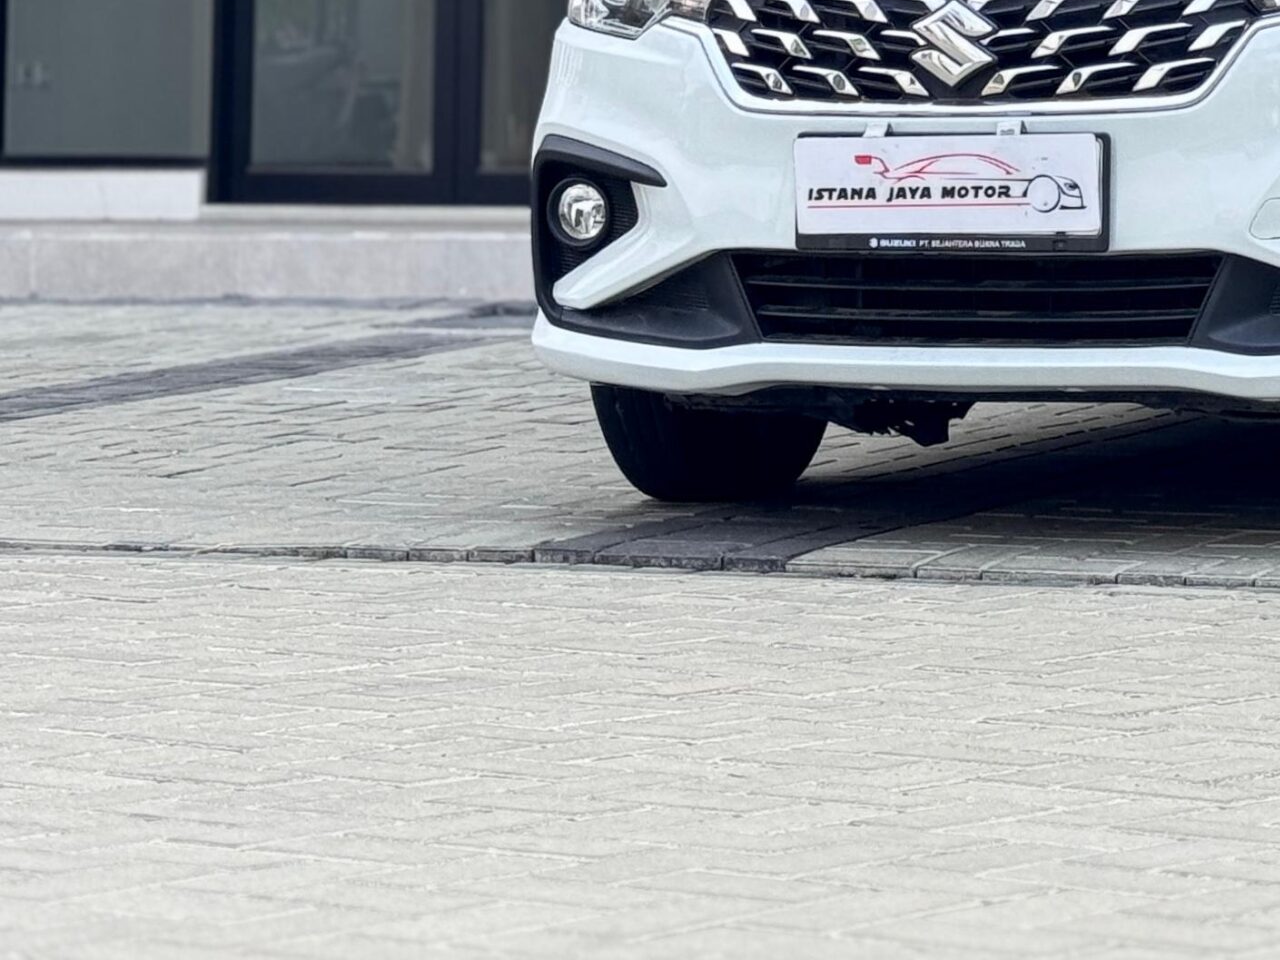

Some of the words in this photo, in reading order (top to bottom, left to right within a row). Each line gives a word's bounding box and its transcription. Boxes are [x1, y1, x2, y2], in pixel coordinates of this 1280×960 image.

[808, 187, 877, 201] ISTANA
[887, 186, 932, 202] JAYA
[941, 185, 1011, 200] MOTOR
